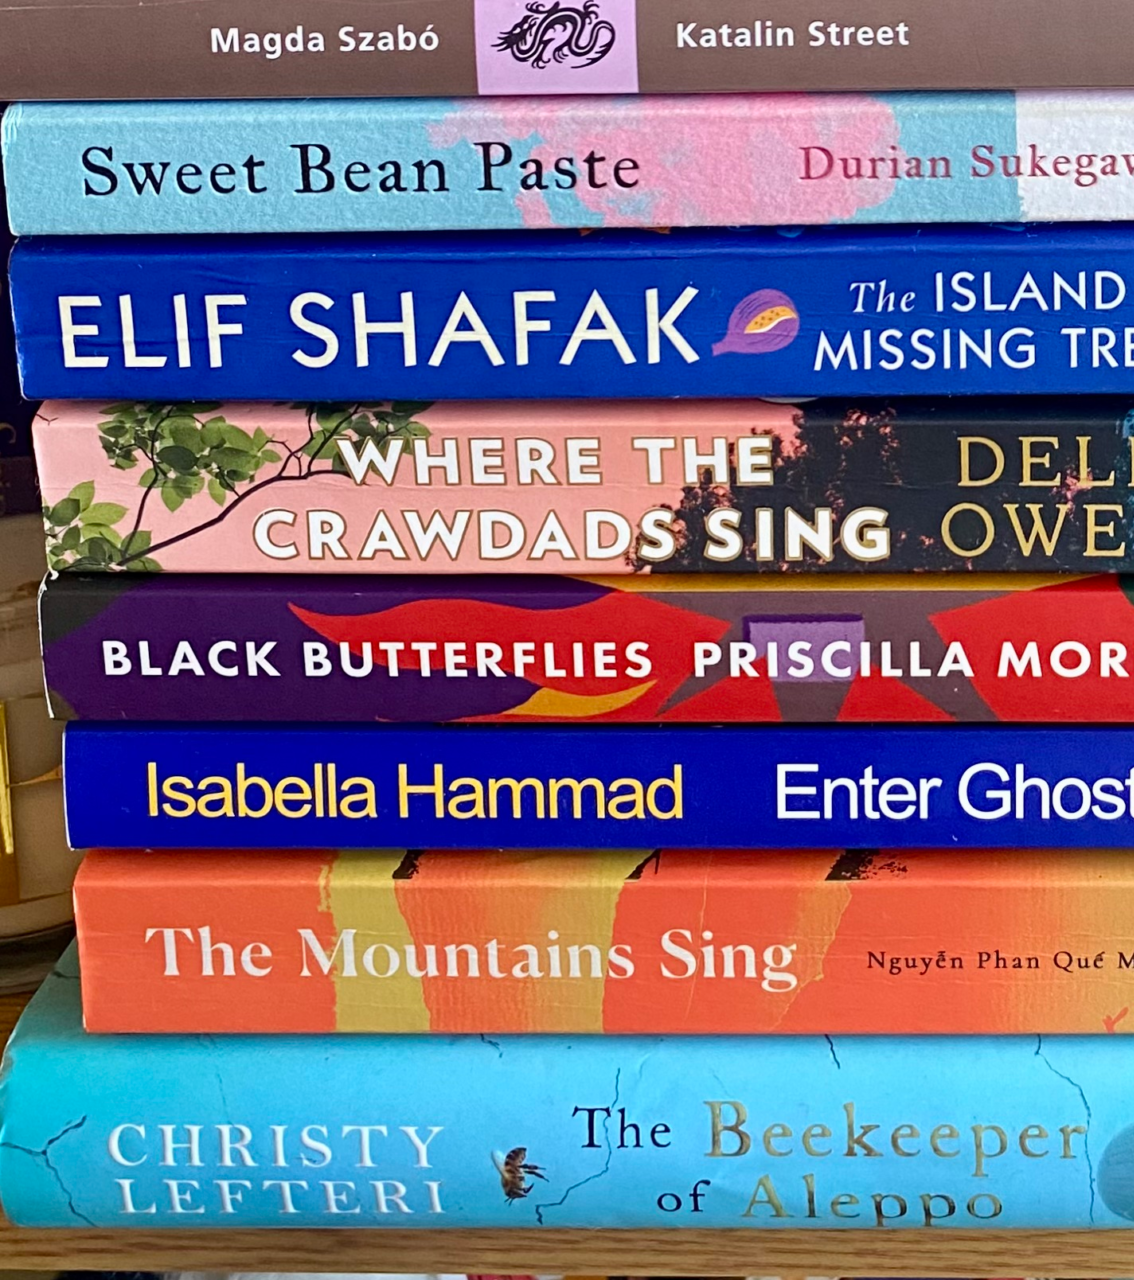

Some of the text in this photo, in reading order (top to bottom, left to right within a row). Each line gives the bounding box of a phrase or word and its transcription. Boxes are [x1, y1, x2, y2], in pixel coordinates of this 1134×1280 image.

[210, 24, 439, 60] Magda Szabó
[675, 20, 910, 49] Katalin Street
[82, 142, 641, 197] Sweet Bean Paste
[799, 145, 951, 182] Durian
[850, 281, 915, 313] The
[935, 271, 1126, 312] ISLAND
[58, 286, 700, 368] ELIF SHAFAK
[813, 327, 1036, 371] MISSING
[336, 436, 774, 485] WHERE THE
[253, 507, 891, 562] CRAWDADS SING
[102, 640, 653, 678] BLACK BUTTERFLIES
[693, 640, 974, 677] PRISCILLA
[147, 762, 683, 819] Isabella Hammad
[776, 763, 942, 820] Enter
[145, 926, 798, 993] The Mountains Sing
[977, 950, 1040, 969] Phan
[108, 1124, 445, 1169] CHRISTY
[572, 1101, 1087, 1179] The Beekeeper
[116, 1178, 445, 1215] LEFTERI
[657, 1175, 1005, 1228] of Aleppo
